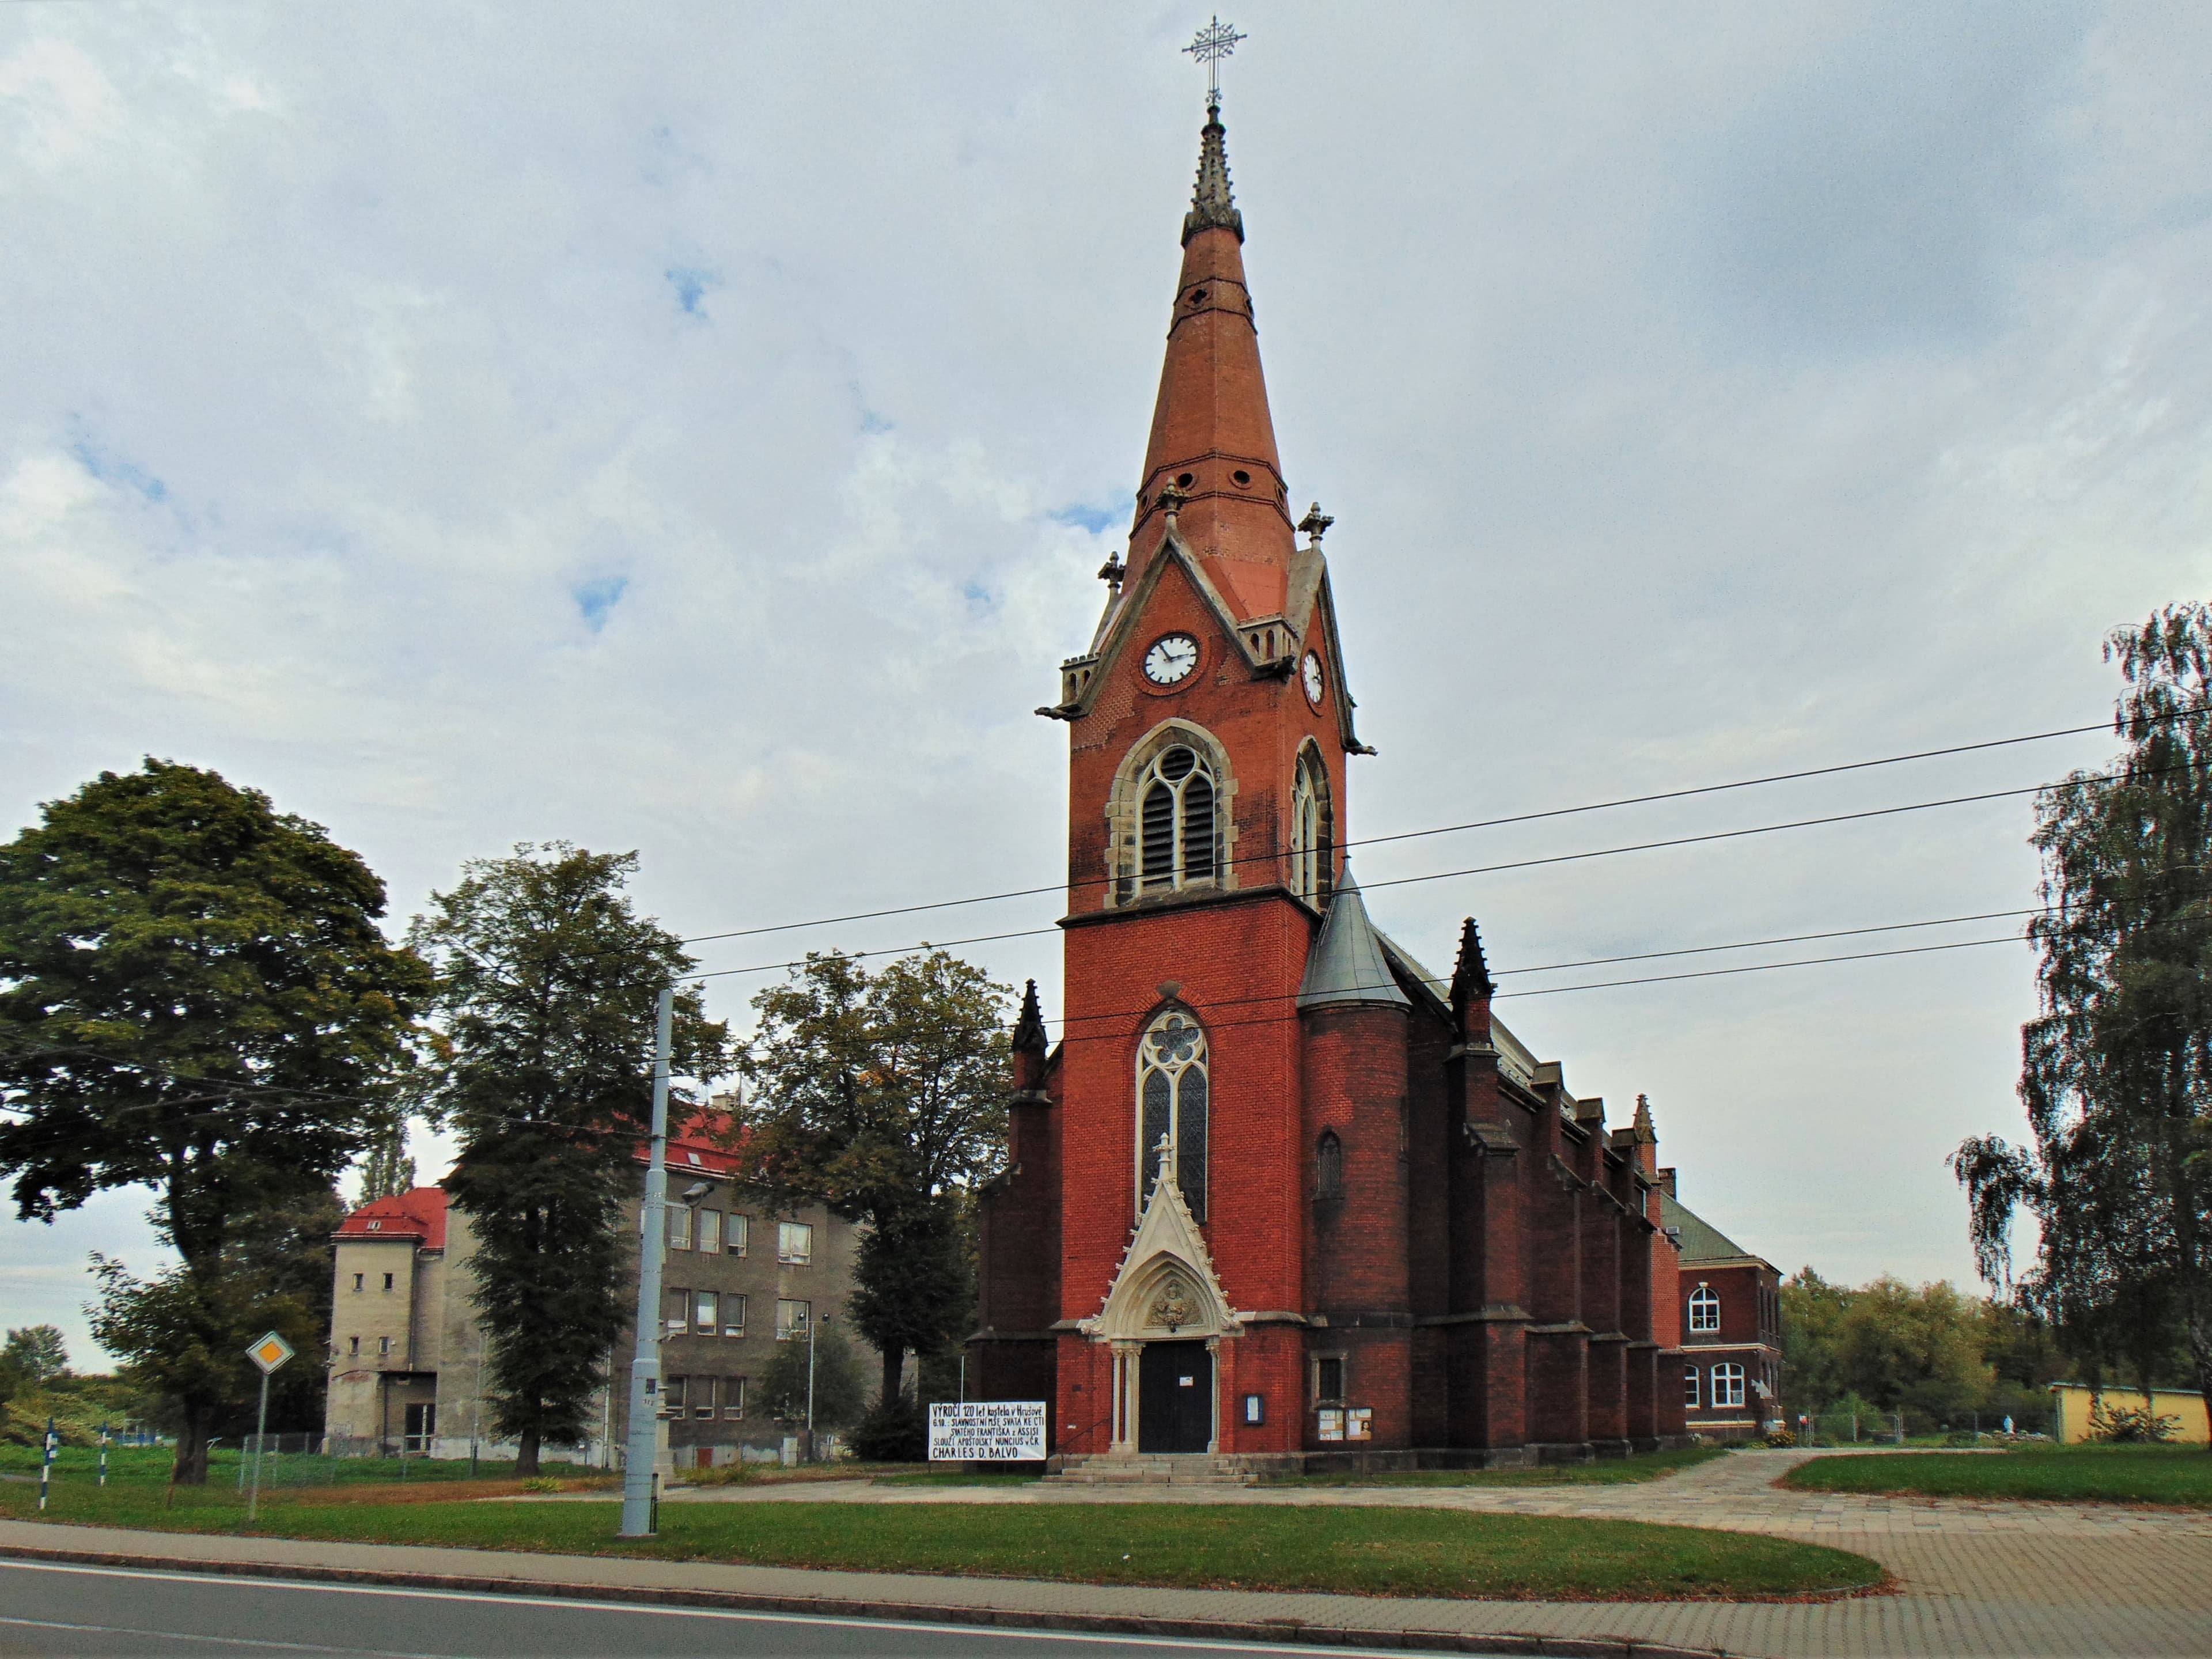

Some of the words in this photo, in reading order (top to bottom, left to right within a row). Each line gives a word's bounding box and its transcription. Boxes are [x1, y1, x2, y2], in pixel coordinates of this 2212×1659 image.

[933, 1403, 960, 1417] VÝROČÍ
[963, 1405, 974, 1416] 120
[976, 1405, 984, 1416] let
[988, 1404, 1009, 1416] kostela
[1017, 1404, 1041, 1416] Hrušově
[952, 1417, 986, 1426] SLAVNOSTNÍ
[988, 1415, 1000, 1426] MŠE
[1003, 1415, 1021, 1426] SVATÁ
[1024, 1417, 1031, 1426] KE
[1034, 1416, 1044, 1426] CTI
[950, 1427, 975, 1436] SVATÉHO
[977, 1426, 1010, 1436] FRANTIŠKA
[1018, 1427, 1038, 1435] ASSISI
[995, 1437, 1023, 1445] NUNCIUS
[1030, 1435, 1039, 1445] ČR
[933, 1447, 974, 1458] CHARLES
[979, 1447, 986, 1458] D.
[989, 1447, 1018, 1458] BALVO
